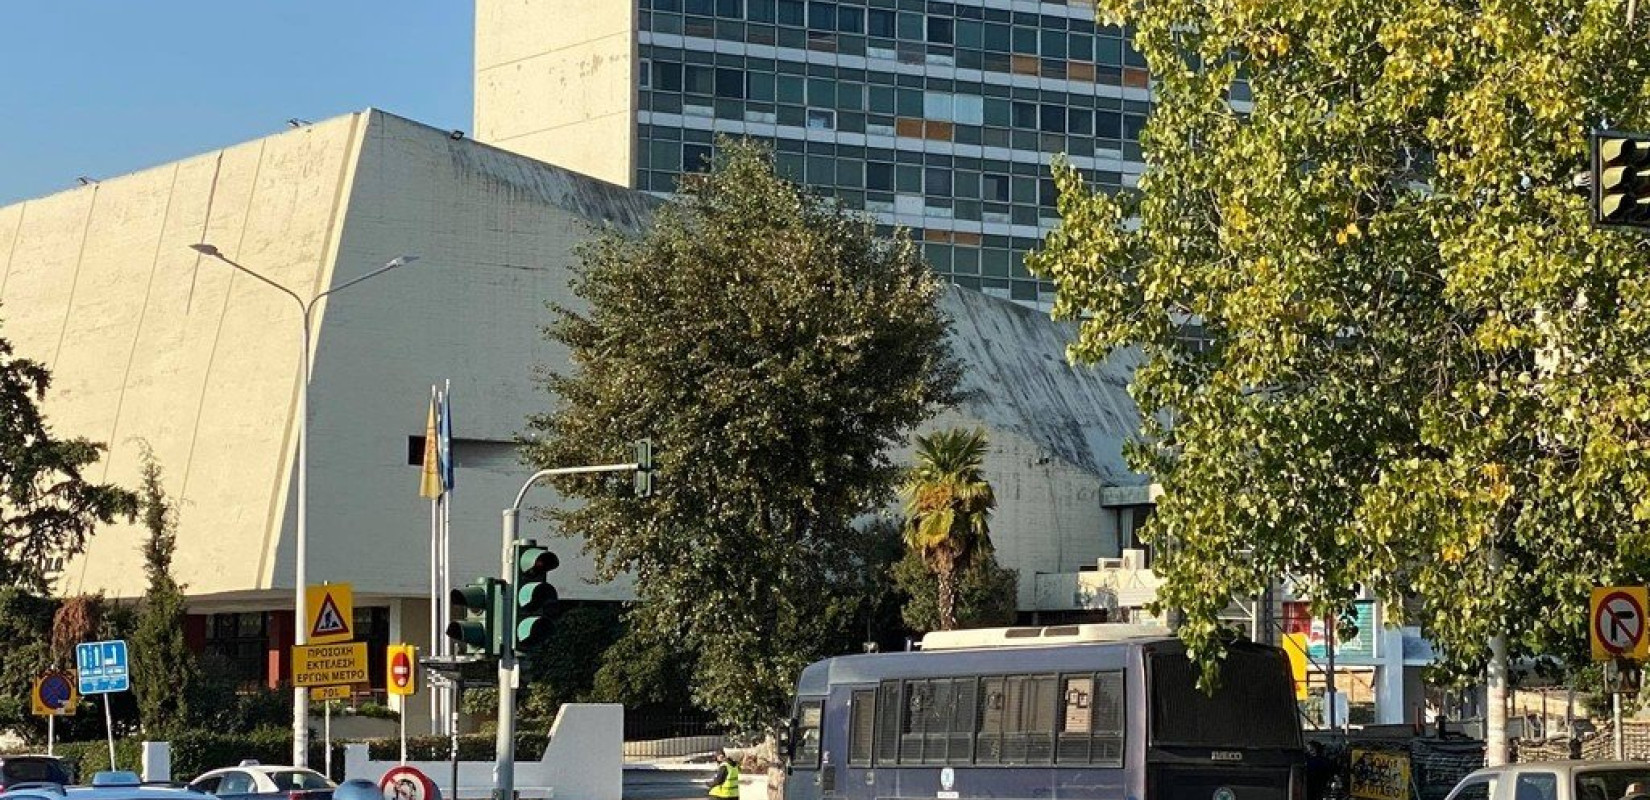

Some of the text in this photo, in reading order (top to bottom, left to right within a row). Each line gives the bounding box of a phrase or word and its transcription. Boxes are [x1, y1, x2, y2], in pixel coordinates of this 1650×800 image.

[307, 646, 354, 658] ΠΡΟΣΟΧΗ
[307, 658, 355, 670] ΕΚΤΕΛΕΣΗ
[297, 669, 365, 683] ΕΡΓΩΝ ΜΕΤΡΟ
